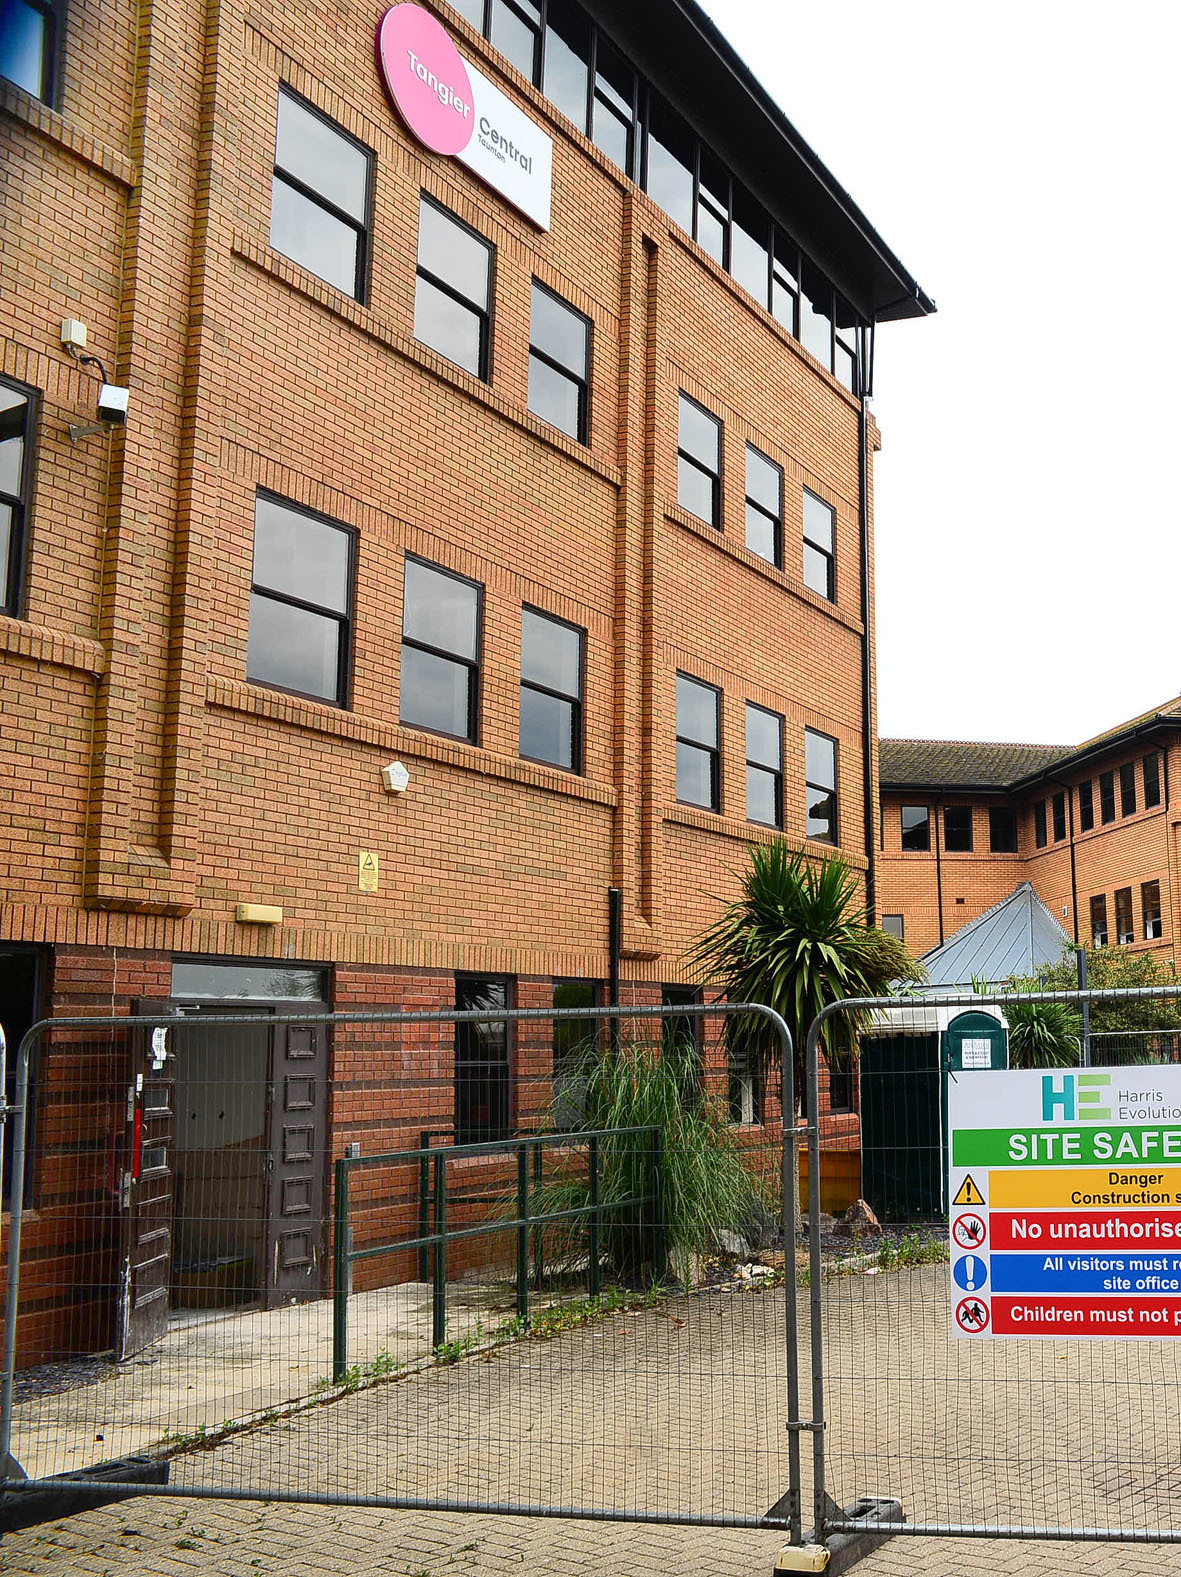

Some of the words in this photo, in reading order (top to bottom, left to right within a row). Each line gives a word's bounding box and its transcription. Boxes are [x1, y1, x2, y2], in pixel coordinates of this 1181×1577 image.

[406, 50, 471, 119] Tangier
[477, 133, 506, 164] Taunton
[479, 117, 532, 175] Central
[1118, 1089, 1164, 1103] Harris
[1008, 1133, 1082, 1161] SITE
[1108, 1172, 1164, 1188] Danger
[1071, 1191, 1171, 1205] Construction
[1011, 1218, 1043, 1239] No
[1043, 1257, 1063, 1271] All
[1067, 1257, 1125, 1272] visitors
[1129, 1258, 1168, 1272] must
[1103, 1276, 1131, 1290] site
[1135, 1276, 1179, 1290] office
[1010, 1305, 1085, 1323] Children
[1089, 1307, 1134, 1323] must
[1139, 1308, 1169, 1323] not
